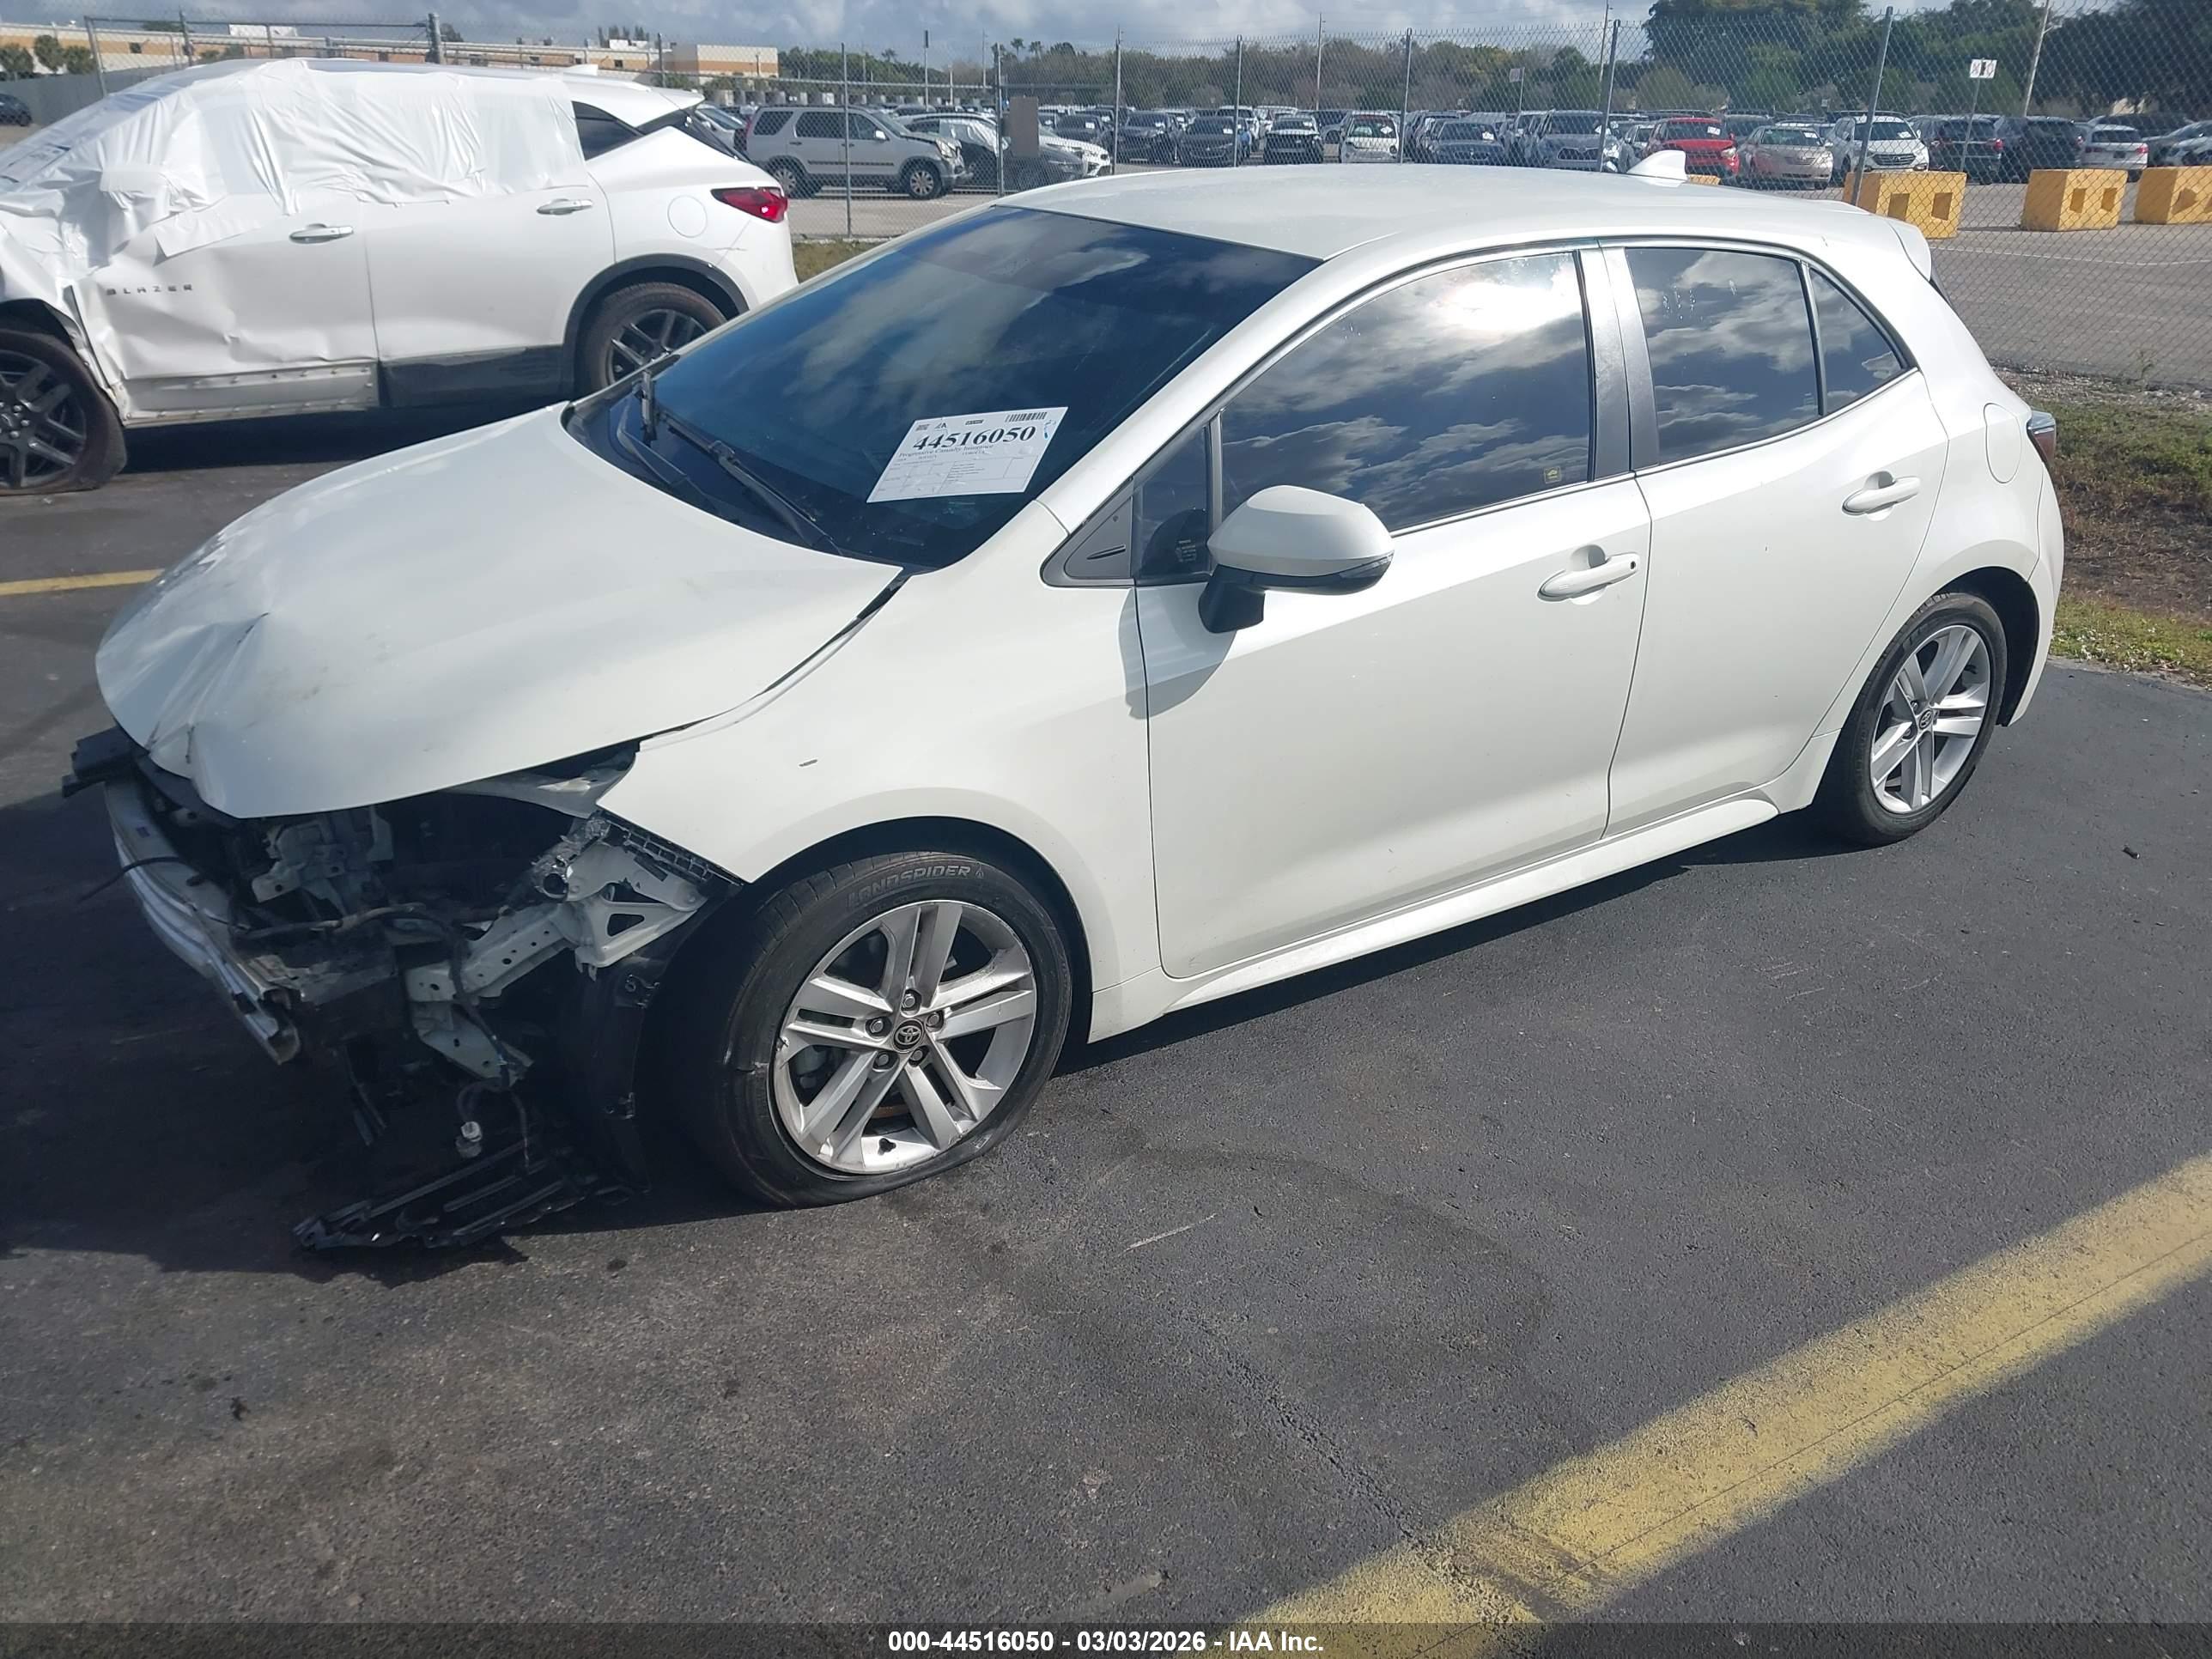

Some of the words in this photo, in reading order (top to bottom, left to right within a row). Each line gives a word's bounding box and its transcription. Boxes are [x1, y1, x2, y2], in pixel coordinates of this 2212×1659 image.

[106, 283, 192, 296] BLAZER
[913, 426, 1036, 451] 44516050
[846, 865, 971, 907] LANDSPIDER
